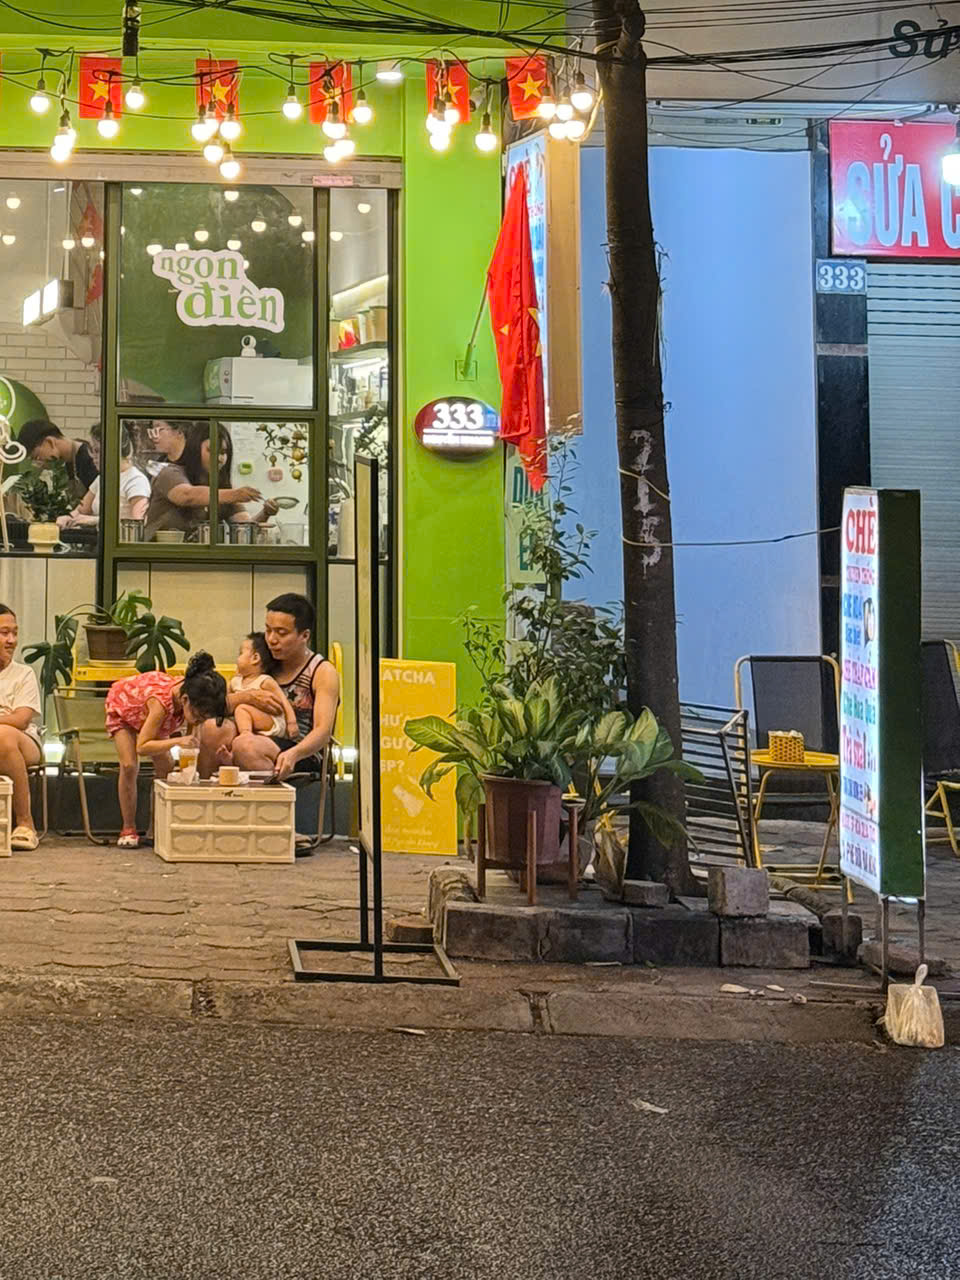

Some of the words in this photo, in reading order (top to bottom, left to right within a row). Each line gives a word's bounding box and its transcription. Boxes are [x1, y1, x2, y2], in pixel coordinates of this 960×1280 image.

[844, 133, 930, 249] SỬA
[159, 254, 241, 286] ngon
[819, 264, 865, 291] 333
[183, 281, 278, 325] điên
[432, 402, 485, 430] 333
[845, 495, 877, 555] CHÈ
[382, 669, 437, 686] ATCHA
